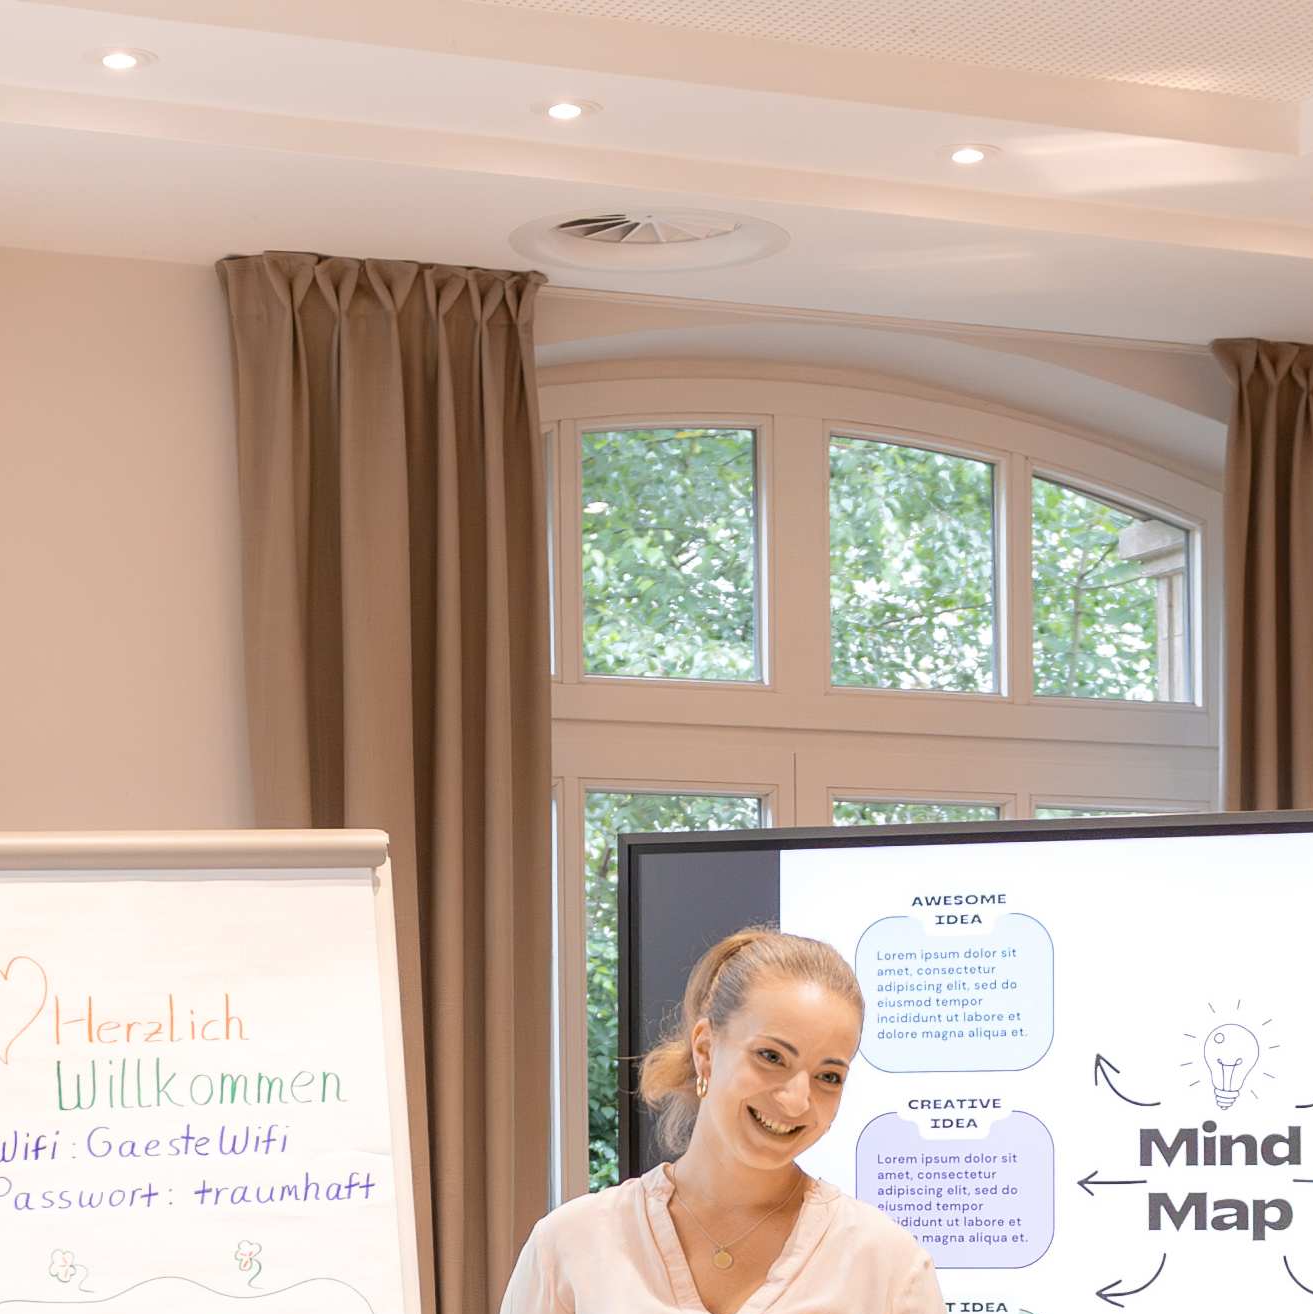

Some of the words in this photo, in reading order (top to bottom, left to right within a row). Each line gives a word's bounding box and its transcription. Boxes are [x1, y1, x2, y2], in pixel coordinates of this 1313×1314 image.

[911, 893, 1007, 907] AWESOME
[934, 913, 983, 925] IDEA
[877, 951, 917, 961] Lorem
[920, 949, 960, 963] ipsum
[963, 947, 998, 959] dolor
[1000, 948, 1017, 958] sit
[877, 967, 913, 977] amet,
[916, 965, 997, 976] consectetur
[877, 980, 943, 995] adipiscing
[946, 979, 970, 992] elit,
[974, 978, 997, 991] sed
[1001, 978, 1018, 990] do
[877, 996, 932, 1008] eiusmod
[935, 997, 983, 1009] tempor
[55, 993, 249, 1044] Herzlich
[877, 1012, 943, 1024] incididunt
[946, 1013, 959, 1023] ut
[963, 1011, 1005, 1023] labore
[1007, 1012, 1021, 1022] et
[877, 1028, 918, 1040] dolore
[921, 1030, 964, 1041] magna
[967, 1027, 1007, 1041] aliqua
[1010, 1027, 1028, 1038] et.
[57, 1057, 347, 1110] Willkommen
[907, 1098, 1002, 1110] CREATIVE
[930, 1118, 978, 1129] IDEA
[1140, 1120, 1301, 1167] Mind
[877, 1153, 918, 1165] Lorem
[921, 1152, 961, 1167] ipsum
[963, 1152, 998, 1164] dolor
[1001, 1152, 1018, 1164] sit
[877, 1170, 914, 1181] amet,
[917, 1169, 997, 1180] consectetur
[194, 1172, 375, 1205] traumhaft
[877, 1183, 943, 1199] adipiscing
[946, 1184, 971, 1197] elit,
[974, 1184, 998, 1196] sed
[1001, 1184, 1018, 1196] do
[935, 1201, 984, 1214] tempor
[946, 1217, 960, 1228] ut
[963, 1215, 1005, 1227] labore
[1008, 1217, 1022, 1227] et
[1148, 1192, 1293, 1241] Map
[922, 1234, 965, 1246] magna
[968, 1231, 1008, 1246] aliqua
[1011, 1232, 1029, 1243] et.
[959, 1302, 1009, 1313] IDEA
